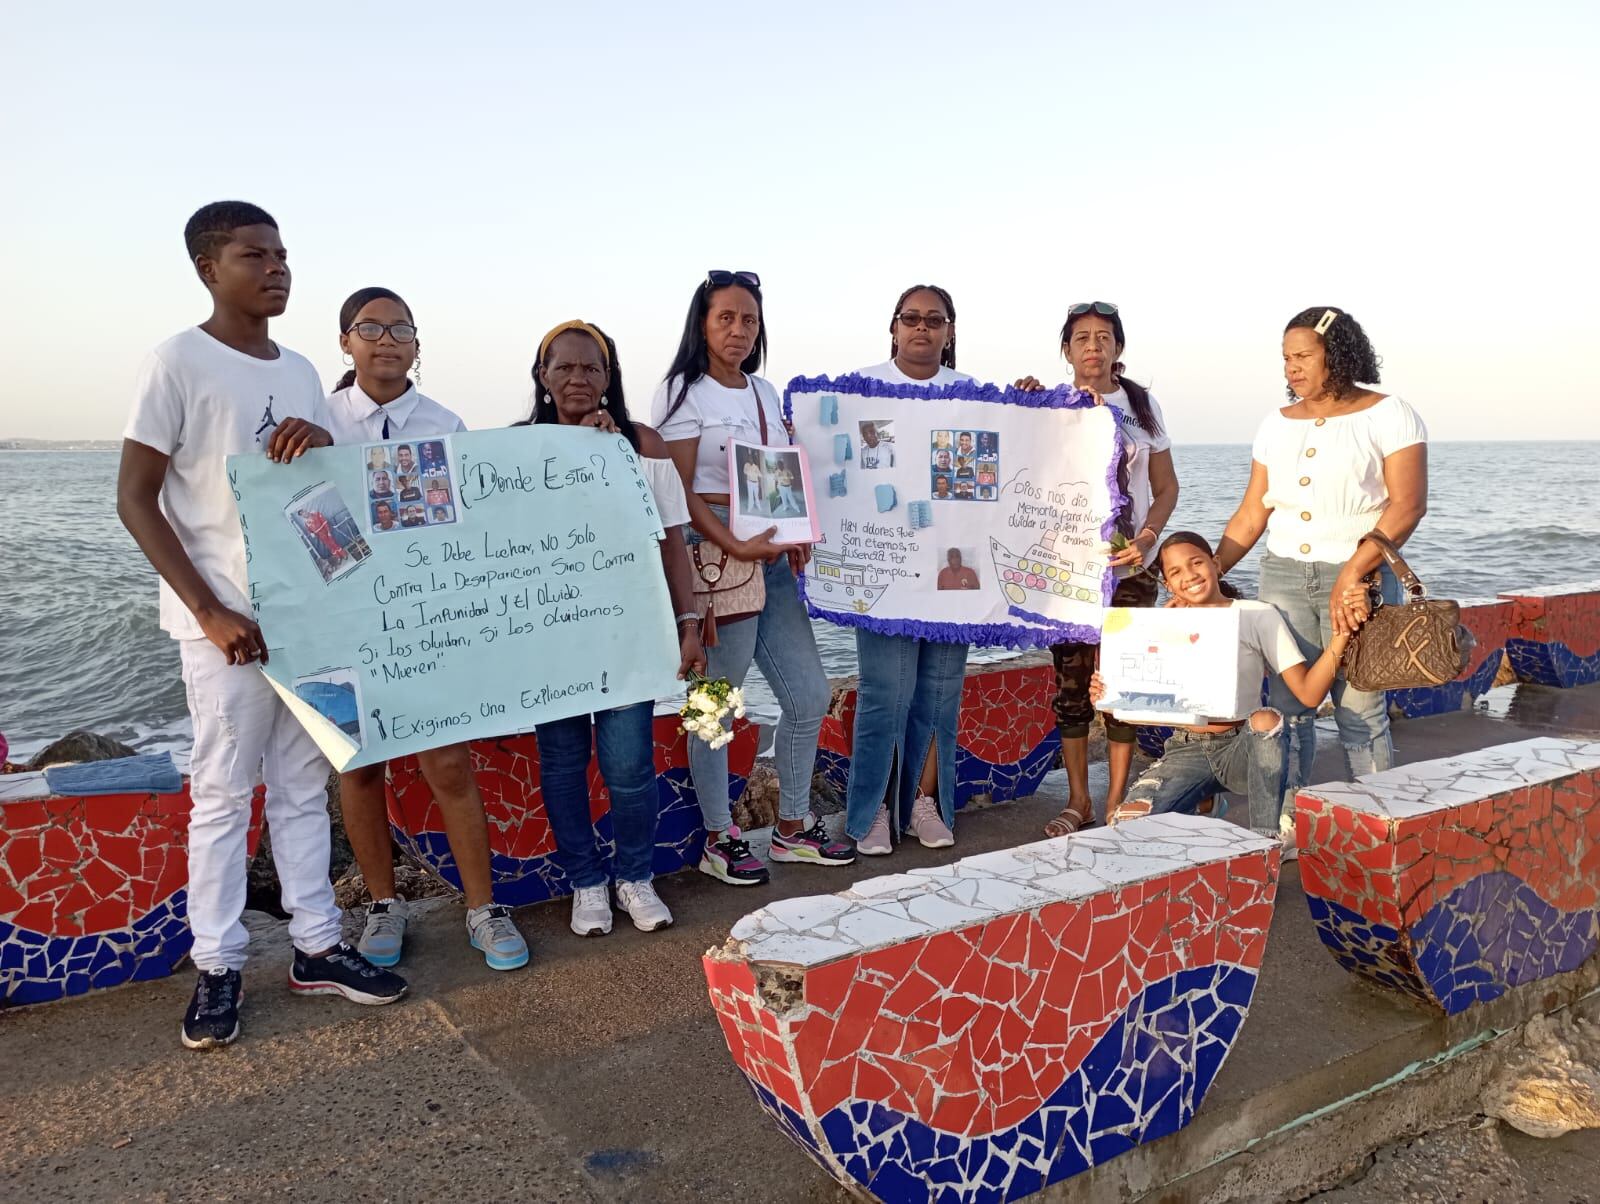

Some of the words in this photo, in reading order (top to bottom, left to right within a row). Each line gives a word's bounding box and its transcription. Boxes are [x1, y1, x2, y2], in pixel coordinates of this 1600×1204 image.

[1014, 480, 1043, 500] Dios
[1047, 490, 1066, 506] nos
[1071, 492, 1088, 508] dio
[1017, 501, 1058, 519] Memoria
[840, 518, 858, 533] Hay
[405, 541, 432, 568] Se
[441, 540, 476, 563] Debe
[484, 532, 534, 560] Luchar,
[841, 533, 861, 547] Son
[373, 575, 423, 605] Contra
[431, 572, 447, 592] La
[551, 557, 586, 576] Sino
[592, 550, 636, 571] Contra
[381, 610, 405, 632] La
[359, 642, 379, 665] Si
[480, 702, 506, 718] Una
